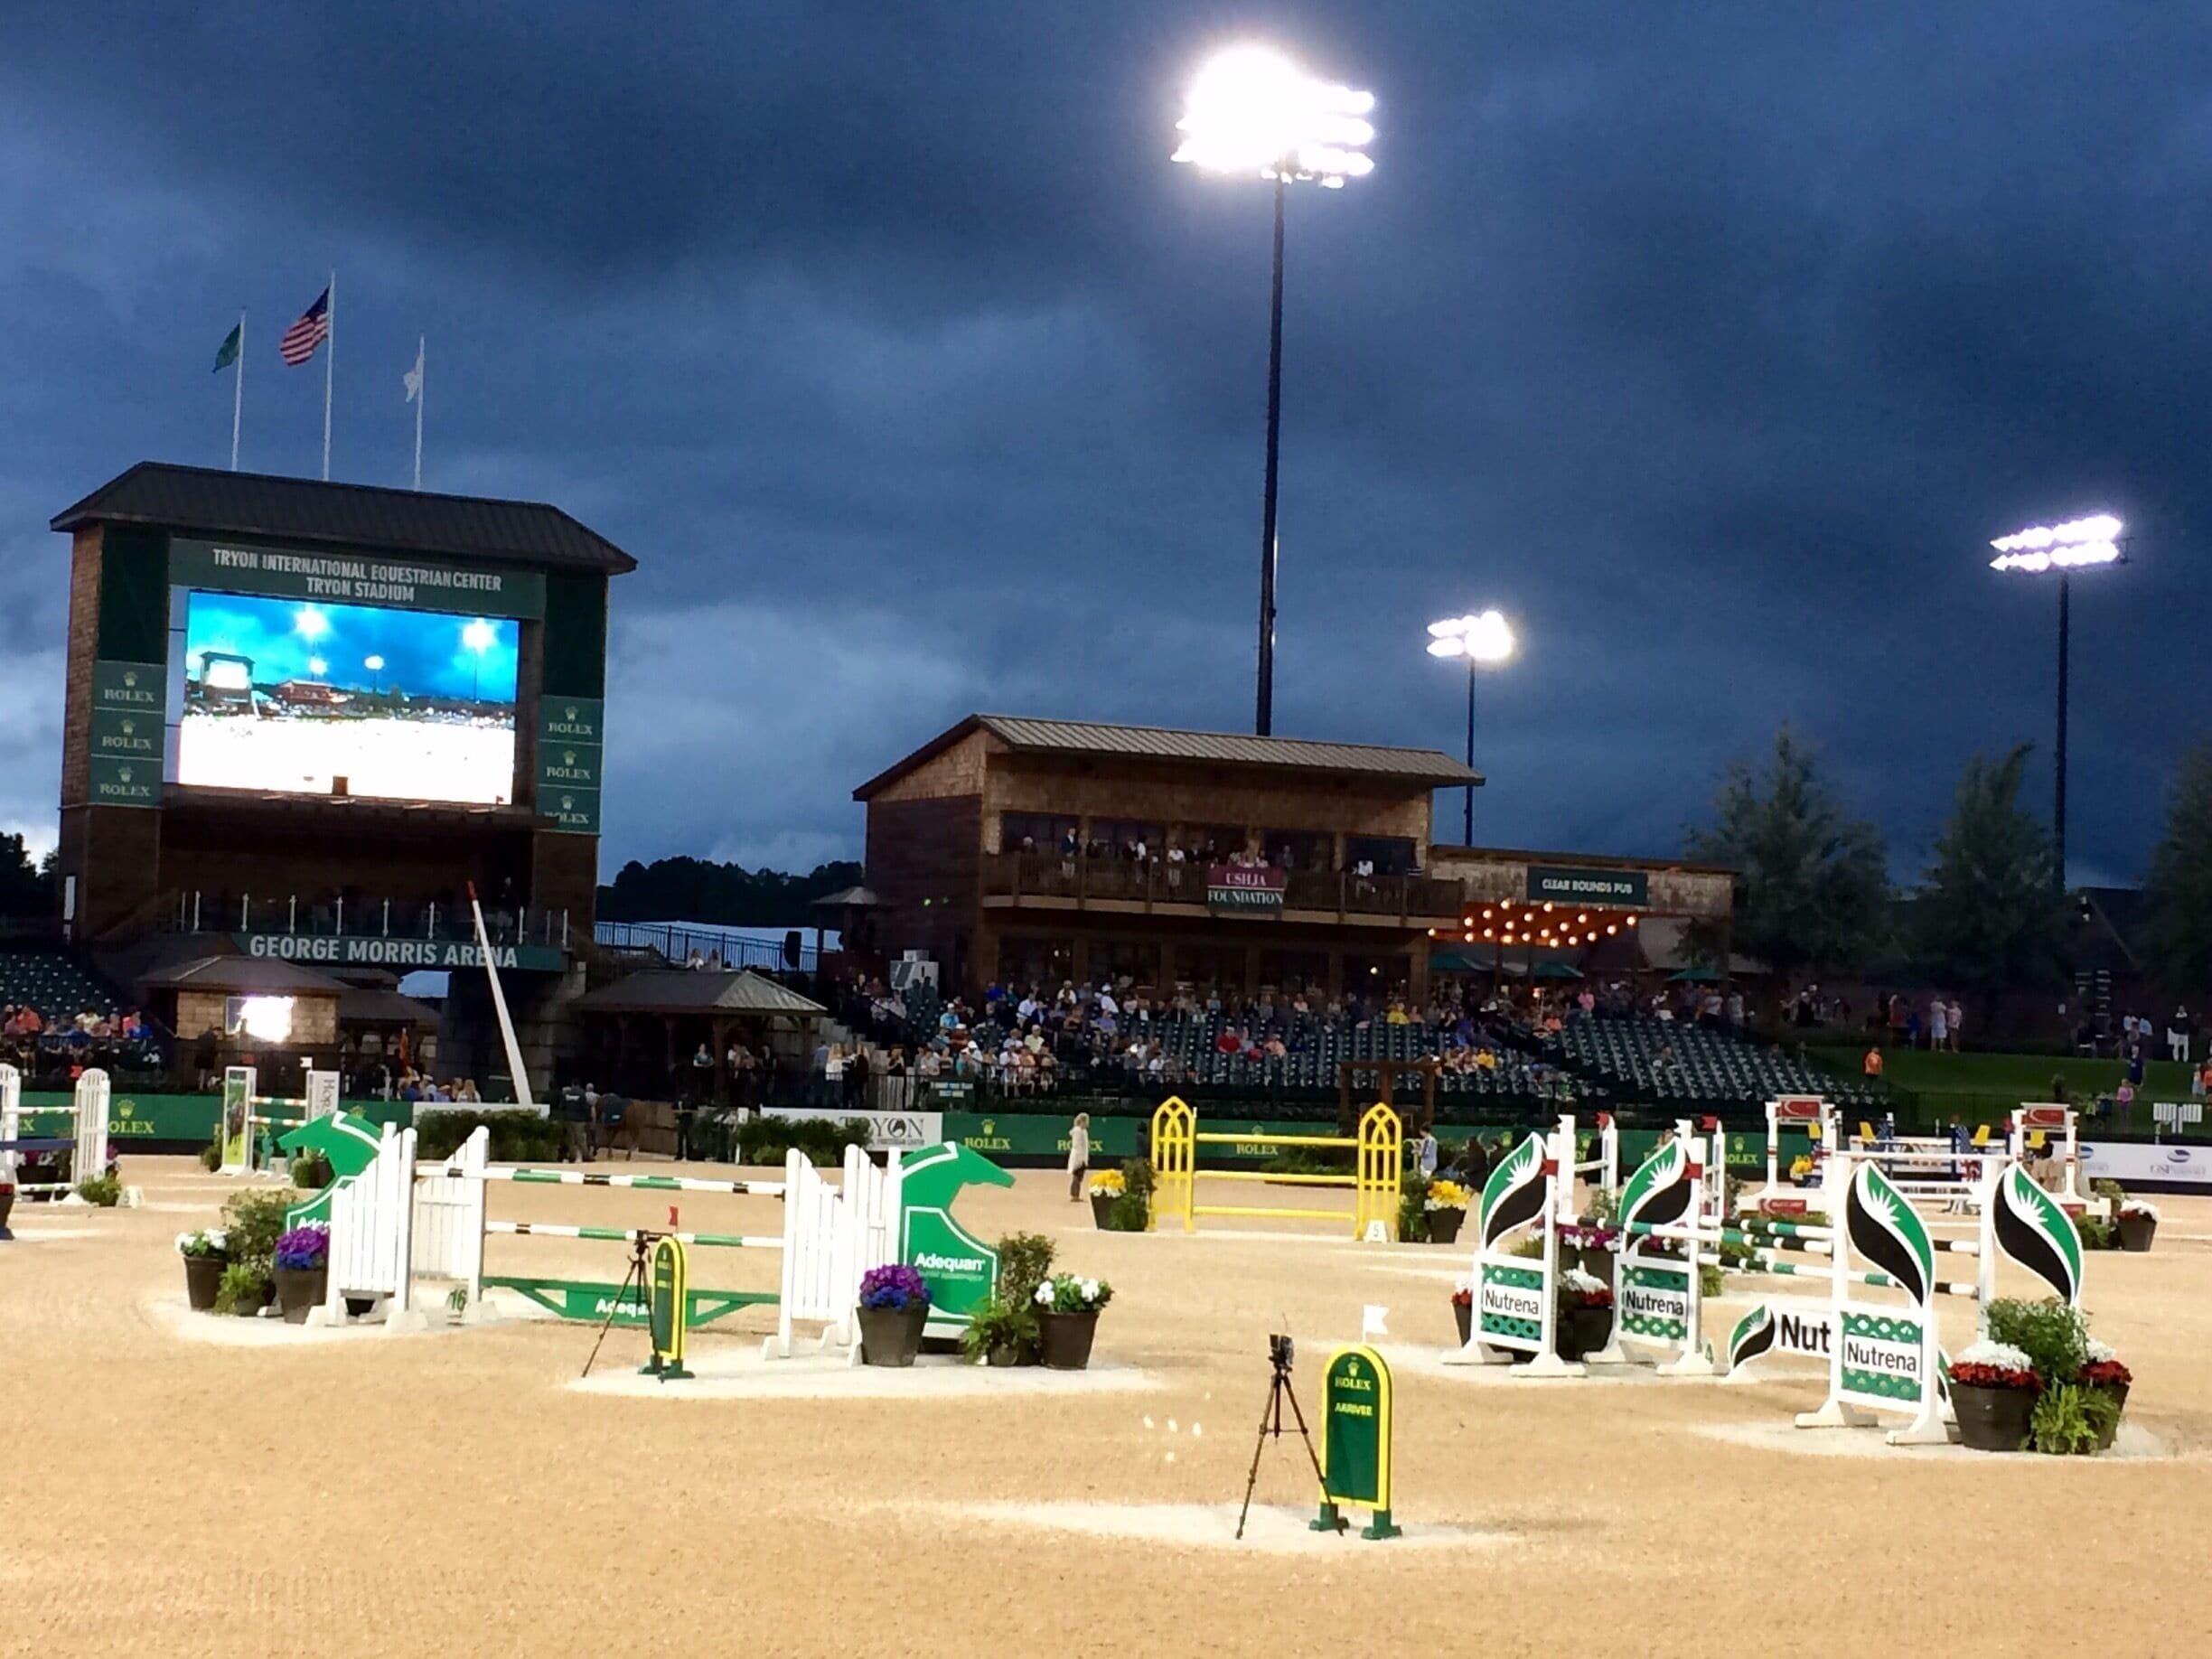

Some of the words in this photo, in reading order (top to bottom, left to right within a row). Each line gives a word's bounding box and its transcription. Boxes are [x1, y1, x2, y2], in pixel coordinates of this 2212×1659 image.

[212, 548, 258, 568] TRYON
[262, 554, 367, 580] INTERNATIONAL
[370, 564, 452, 586] EQUESTRIAN
[453, 572, 501, 591] CENTER
[306, 576, 351, 596] TRYON
[354, 581, 415, 602] STADIUM
[104, 689, 155, 702] ROLEX
[548, 722, 593, 736] ROLEX
[101, 736, 152, 750] ROLEX
[547, 766, 591, 780] ROLEX
[99, 783, 152, 796] ROLEX
[1542, 878, 1570, 891] CLEAR
[1572, 879, 1611, 893] ROUNDS
[1614, 882, 1633, 895] PUB
[1208, 889, 1283, 904] FOUNDATION
[249, 935, 340, 961] GEORGE
[347, 940, 437, 965] MORRIS
[443, 944, 518, 968] ARENA
[108, 1120, 155, 1134] OLEX
[965, 1137, 1011, 1149] ROLEX
[1236, 1143, 1279, 1155] ROLEX
[1485, 1289, 1539, 1315] Nutrena
[1626, 1290, 1683, 1316] Nutrena
[1847, 1342, 1917, 1372] Nutrena
[1335, 1376, 1372, 1391] ROLEX
